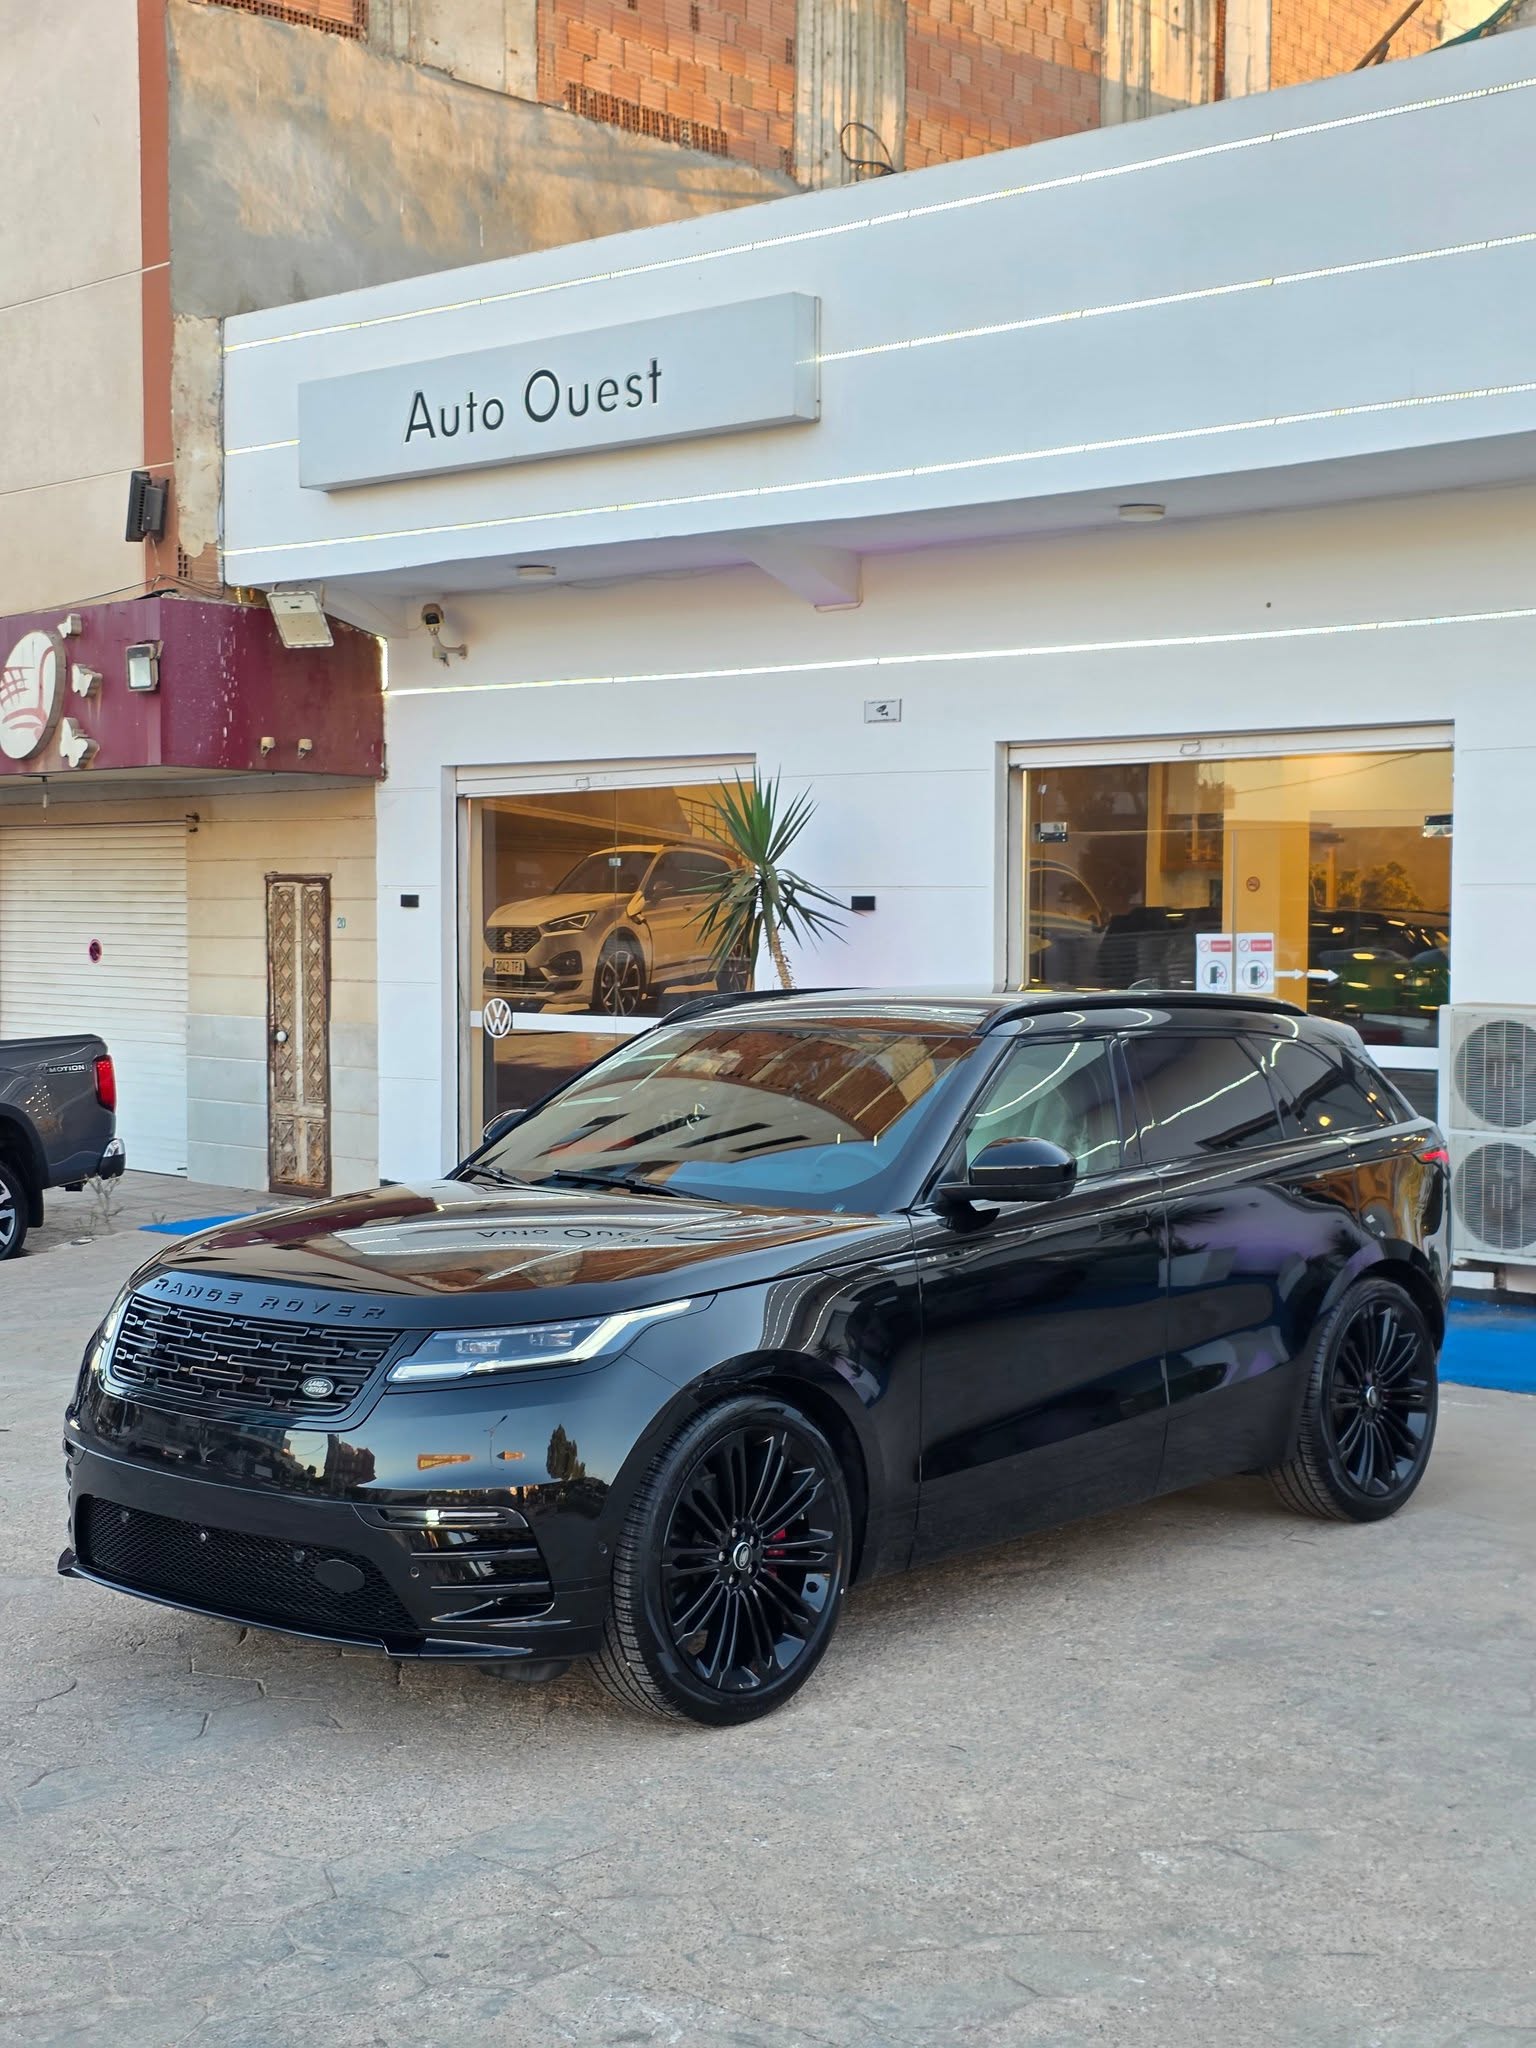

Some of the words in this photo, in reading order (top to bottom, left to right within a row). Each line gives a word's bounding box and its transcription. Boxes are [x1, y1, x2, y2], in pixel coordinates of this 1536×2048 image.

[402, 389, 505, 444] Auto
[524, 358, 663, 423] Ouest
[336, 917, 346, 929] 20
[152, 1277, 244, 1305] RANGE
[259, 1295, 386, 1320] ROVER
